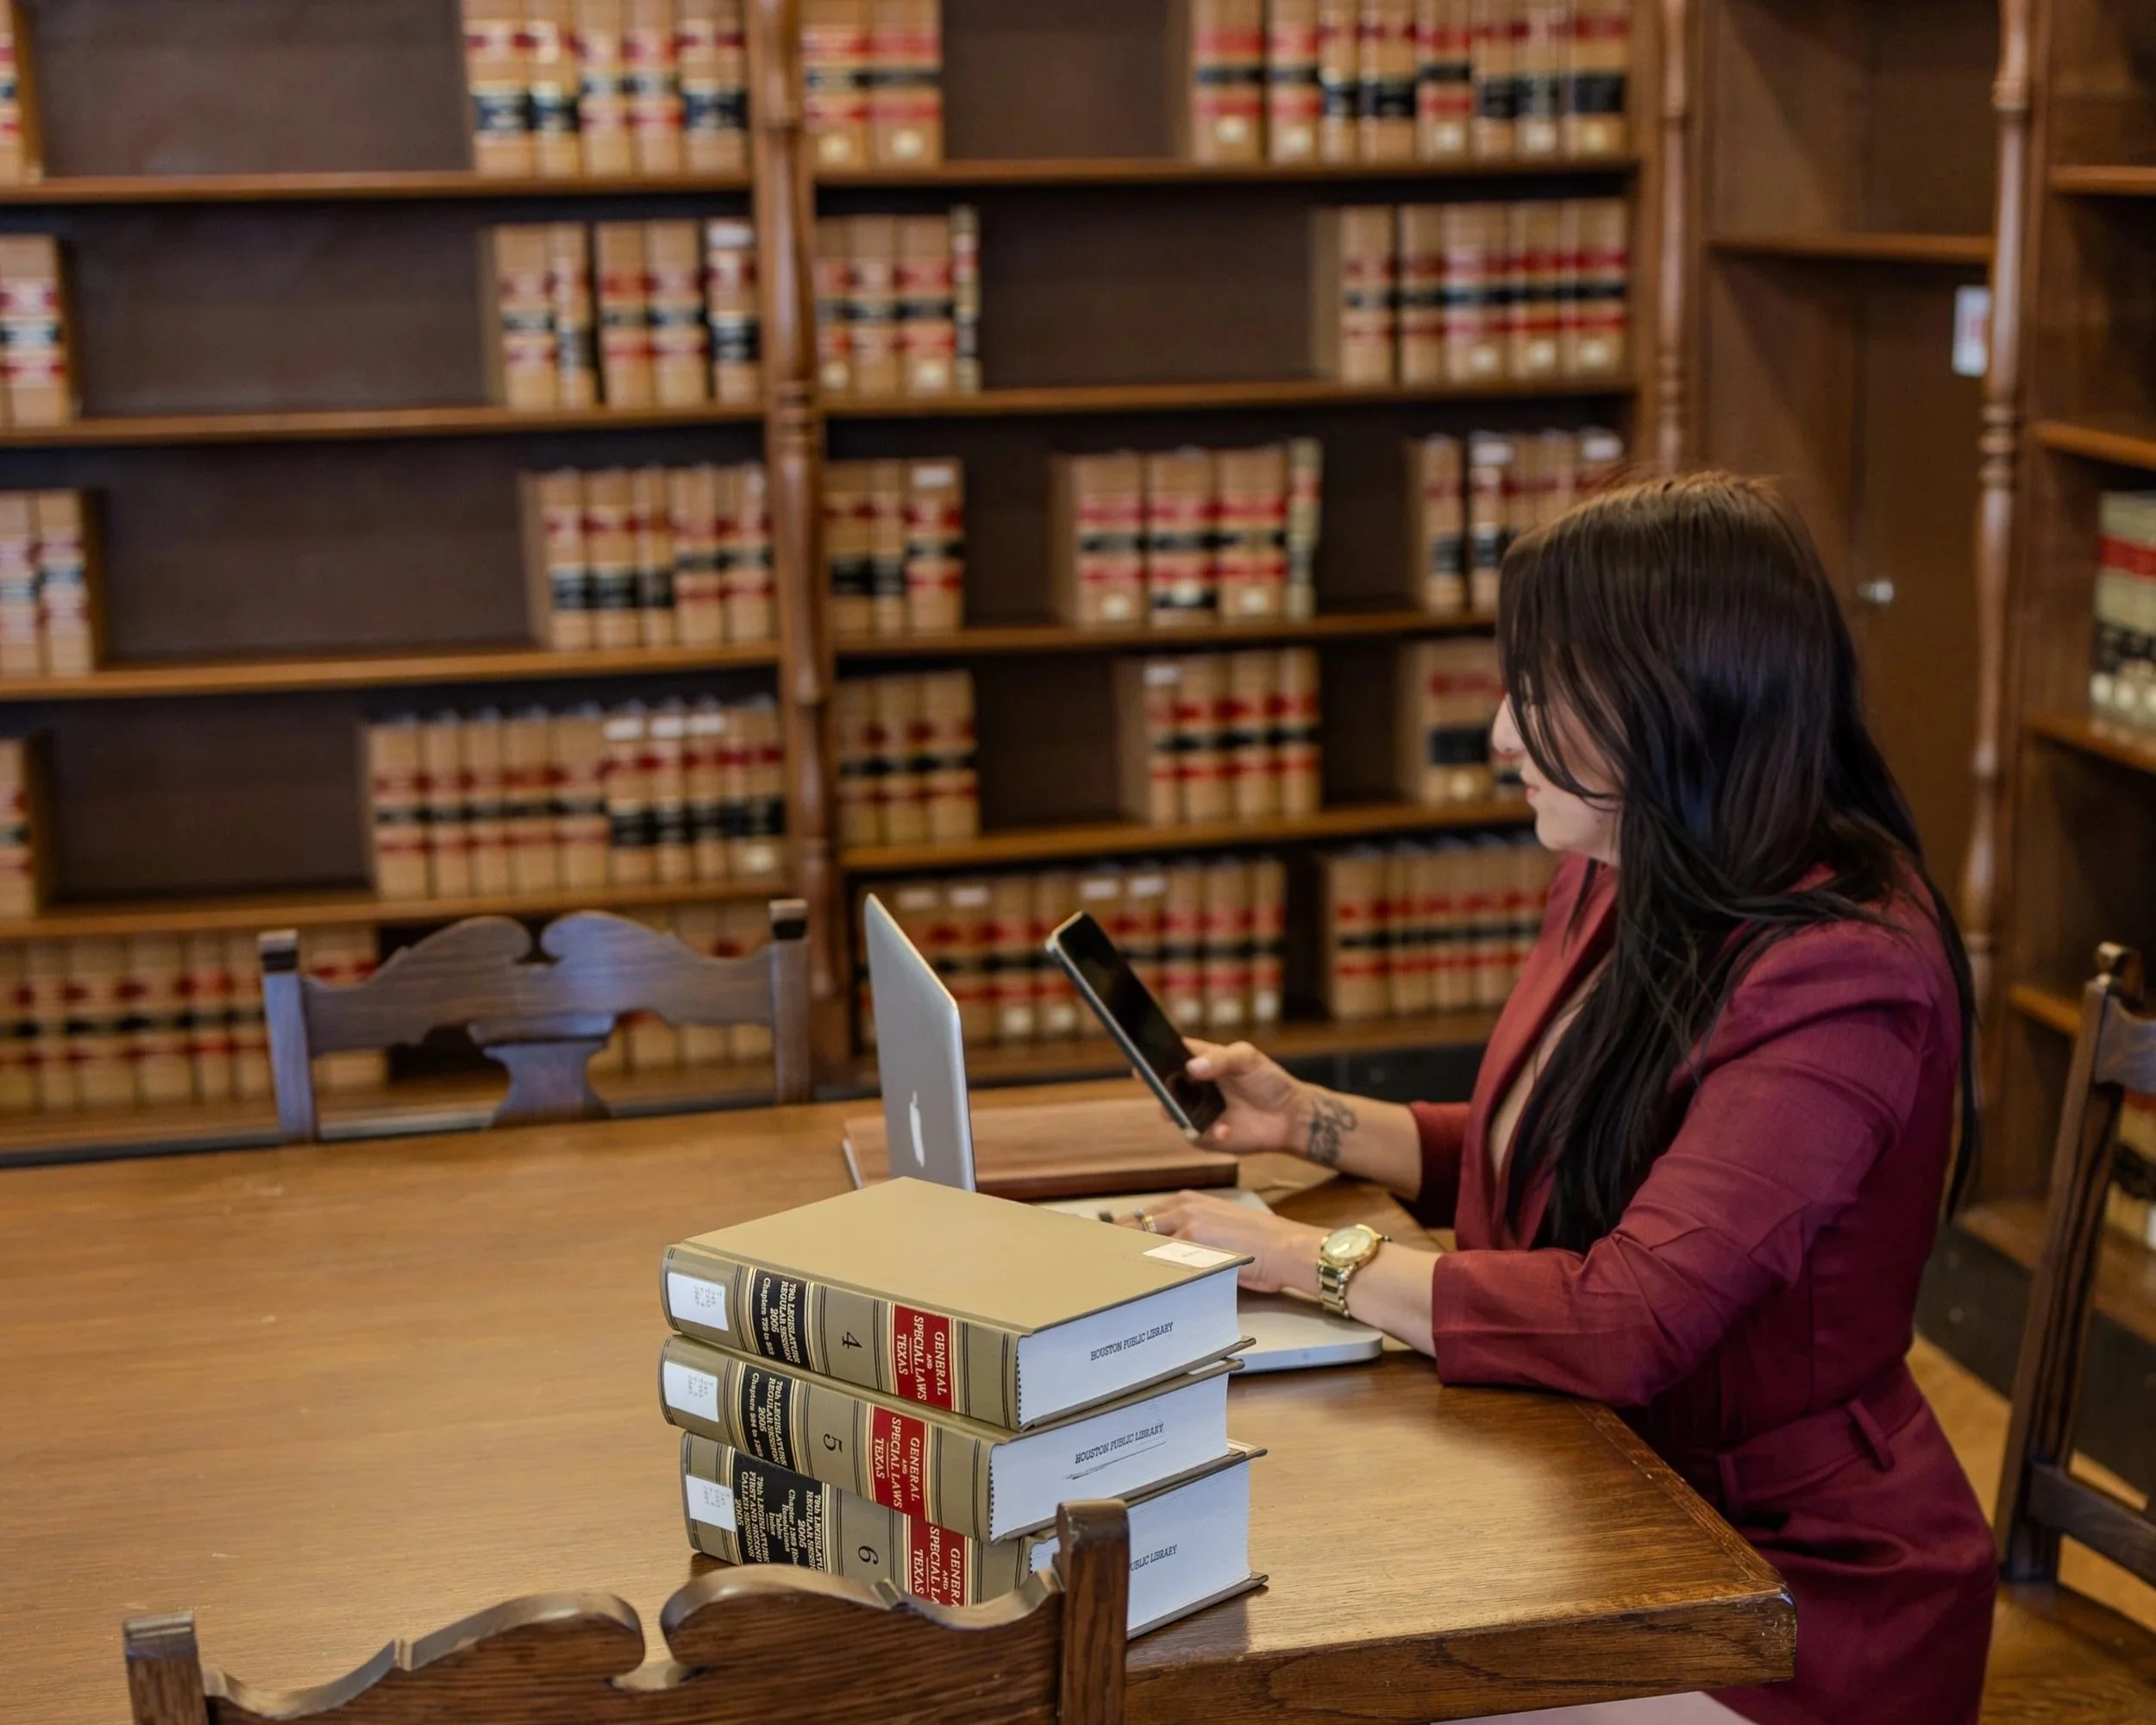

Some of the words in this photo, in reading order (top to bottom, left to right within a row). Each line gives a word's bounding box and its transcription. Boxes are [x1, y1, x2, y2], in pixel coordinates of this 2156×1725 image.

[761, 1277, 771, 1315] Chapters
[780, 1281, 788, 1324] REGULAR
[770, 1308, 780, 1333] 2005
[787, 1304, 800, 1364] LEGISLATURE
[842, 1331, 862, 1349] 4
[914, 1314, 924, 1365] SPECIAL
[780, 1325, 793, 1362] SESSION
[897, 1333, 908, 1375] TEXAS
[1090, 1341, 1123, 1361] HOUSTON
[1123, 1333, 1145, 1350] PUBLIC
[1146, 1321, 1173, 1340] LIBRARY
[935, 1331, 947, 1396] GENERAL
[749, 1372, 759, 1411] Chapters
[767, 1377, 776, 1424] REGULAR
[774, 1381, 783, 1399] 79th
[914, 1368, 927, 1401] LAWS
[758, 1406, 767, 1433] 2005
[774, 1401, 787, 1466] LEGISLATURE
[768, 1425, 780, 1464] SESSION
[823, 1433, 843, 1454] 5
[874, 1438, 885, 1479] TEXAS
[890, 1416, 900, 1470] SPECIAL
[1075, 1442, 1109, 1465] HOUSTON
[1110, 1433, 1134, 1451] PUBLIC
[1135, 1423, 1164, 1441] LIBRARY
[910, 1437, 920, 1502] GENERAL
[892, 1472, 902, 1509] LAWS
[735, 1498, 743, 1527] 2005
[757, 1497, 769, 1563] LEGISLATURE
[743, 1511, 755, 1558] SESSIONS
[752, 1523, 762, 1563] SECOND
[798, 1519, 806, 1548] 2005
[814, 1516, 824, 1571] LEGISLATU
[857, 1546, 879, 1565] 6
[914, 1549, 924, 1594] TEXAS
[930, 1526, 940, 1585] SPECIAL
[1130, 1555, 1150, 1571] UBLIC
[1150, 1544, 1178, 1563] LIBRARY
[931, 1587, 941, 1604] LA
[950, 1547, 961, 1607] GENERA
